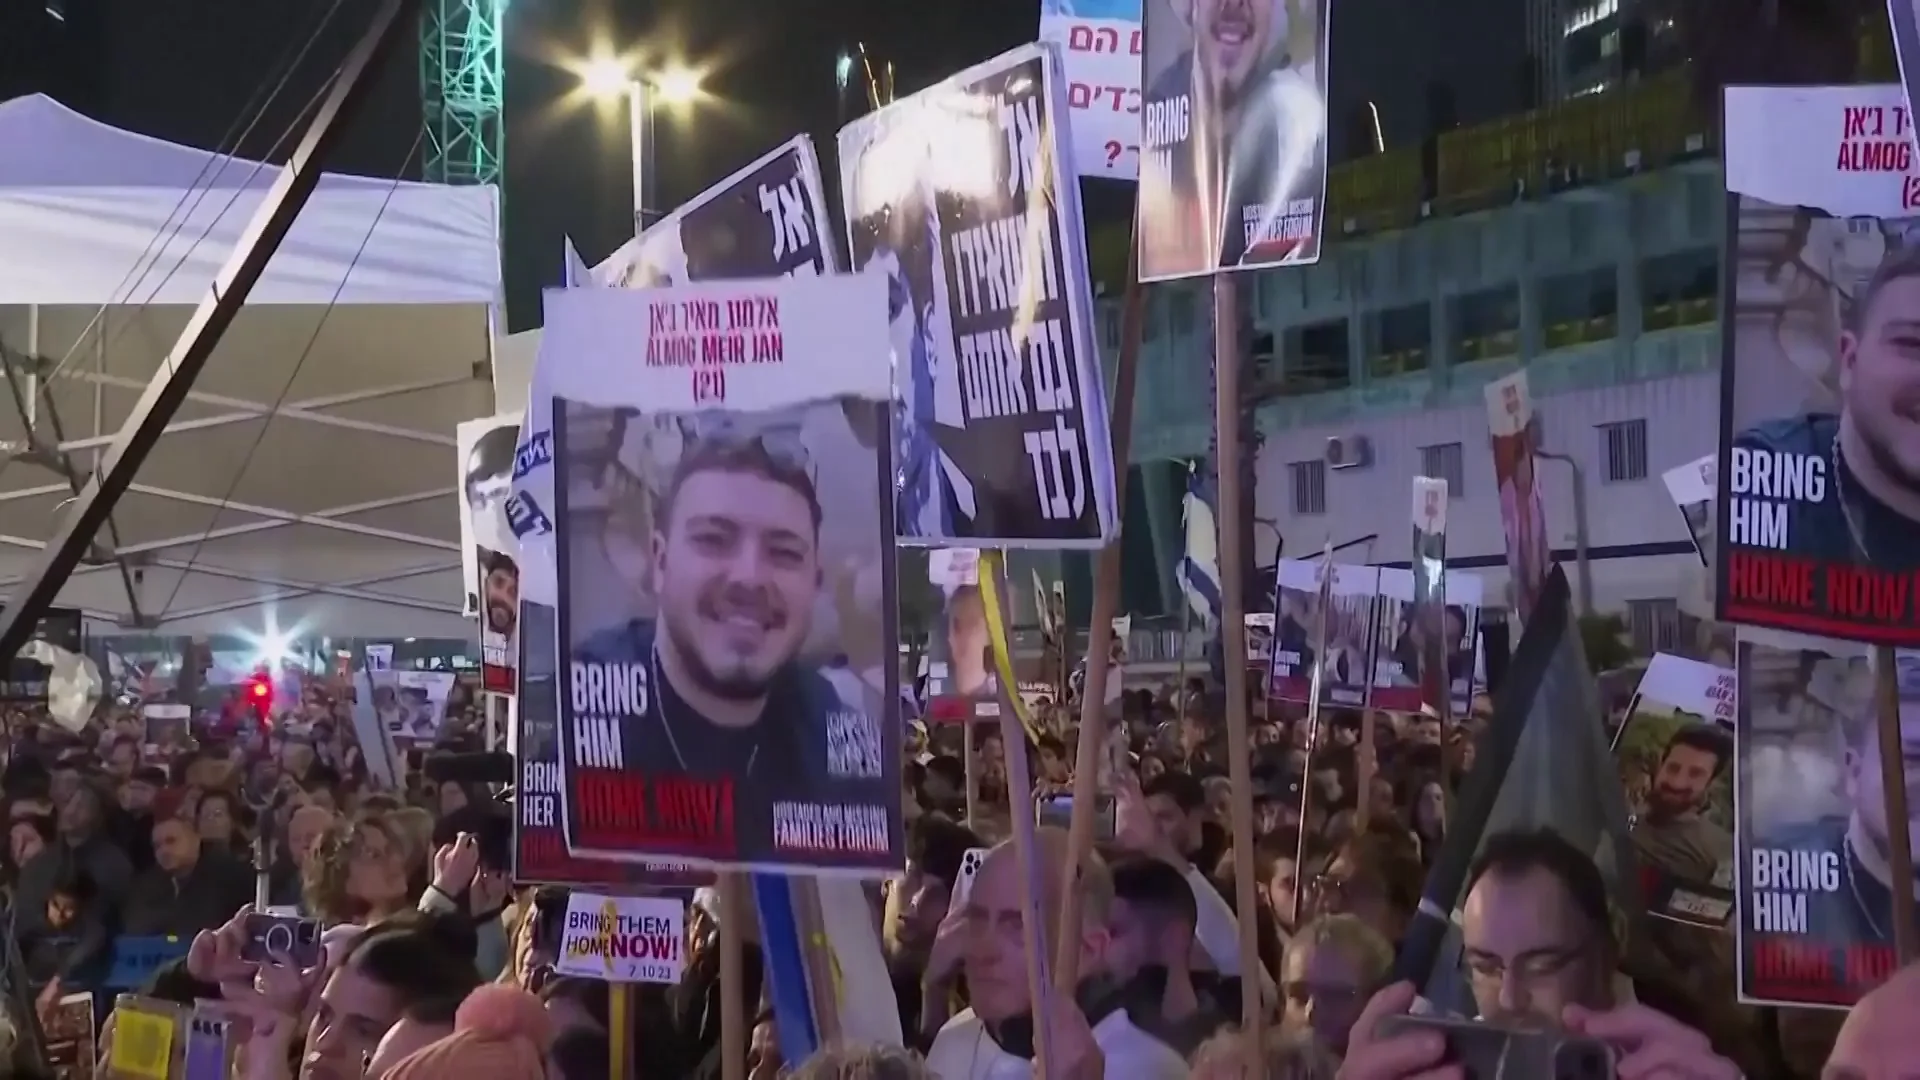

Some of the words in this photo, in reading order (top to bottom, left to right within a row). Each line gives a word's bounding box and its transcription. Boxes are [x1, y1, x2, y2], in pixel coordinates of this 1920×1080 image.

[1069, 25, 1118, 53] הם
[997, 93, 1043, 199] אל
[1146, 94, 1189, 148] BRING
[1837, 141, 1912, 172] ALMOG
[758, 178, 810, 263] אל
[646, 336, 696, 367] ALMOG
[702, 334, 745, 365] MEIR
[752, 332, 783, 364] JAN
[959, 326, 1029, 419] אותם
[1027, 319, 1073, 411] גם
[1731, 447, 1825, 503] BRING
[1730, 497, 1788, 550] HIM
[1729, 552, 1816, 607] HOME
[571, 660, 647, 716] BRING
[573, 717, 624, 770] HIM
[522, 795, 554, 827] HER
[1752, 848, 1839, 892] BRING
[569, 911, 611, 934] BRING
[616, 915, 670, 936] THEM
[1752, 892, 1808, 933] HIM
[566, 934, 610, 958] HOME
[610, 933, 677, 961] NOW!
